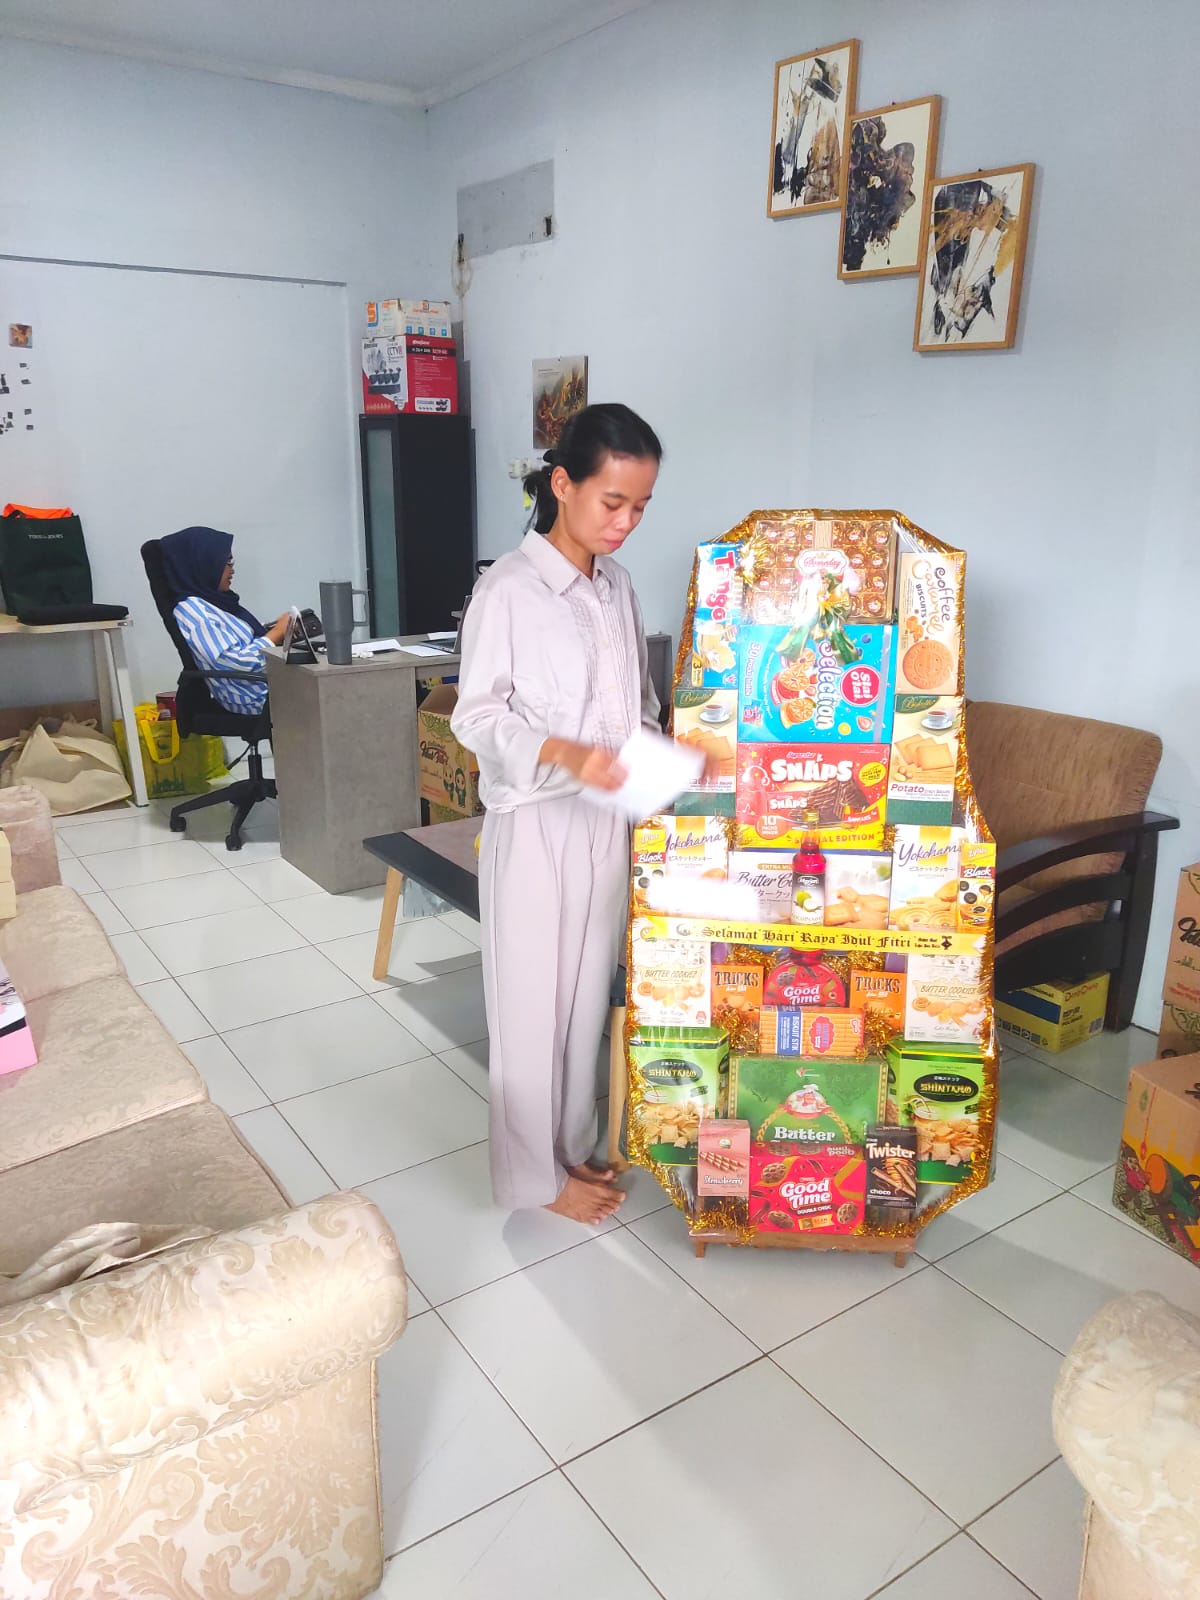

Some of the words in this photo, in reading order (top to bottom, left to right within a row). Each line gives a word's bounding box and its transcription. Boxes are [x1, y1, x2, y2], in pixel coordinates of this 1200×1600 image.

[915, 583, 927, 619] BISCUITS
[749, 642, 761, 657] 30
[816, 640, 842, 728] Selection
[890, 784, 925, 794] Potato
[762, 814, 777, 827] 10
[835, 833, 875, 844] EDITION
[963, 866, 993, 878] Black
[702, 925, 758, 940] Selamat
[761, 929, 795, 943] Hari
[800, 931, 836, 946] Raya
[841, 934, 873, 947] Idul
[875, 936, 911, 949] Fitri
[714, 970, 760, 988] TRICKS
[855, 976, 900, 994] TRICKS
[783, 984, 820, 998] Good
[920, 984, 947, 994] BUTTER
[789, 995, 821, 1006] Time
[774, 1126, 836, 1141] Butter
[865, 1141, 916, 1160] Twister
[704, 1175, 744, 1188] Strawberry
[780, 1178, 830, 1197] Good
[789, 1192, 832, 1210] Time
